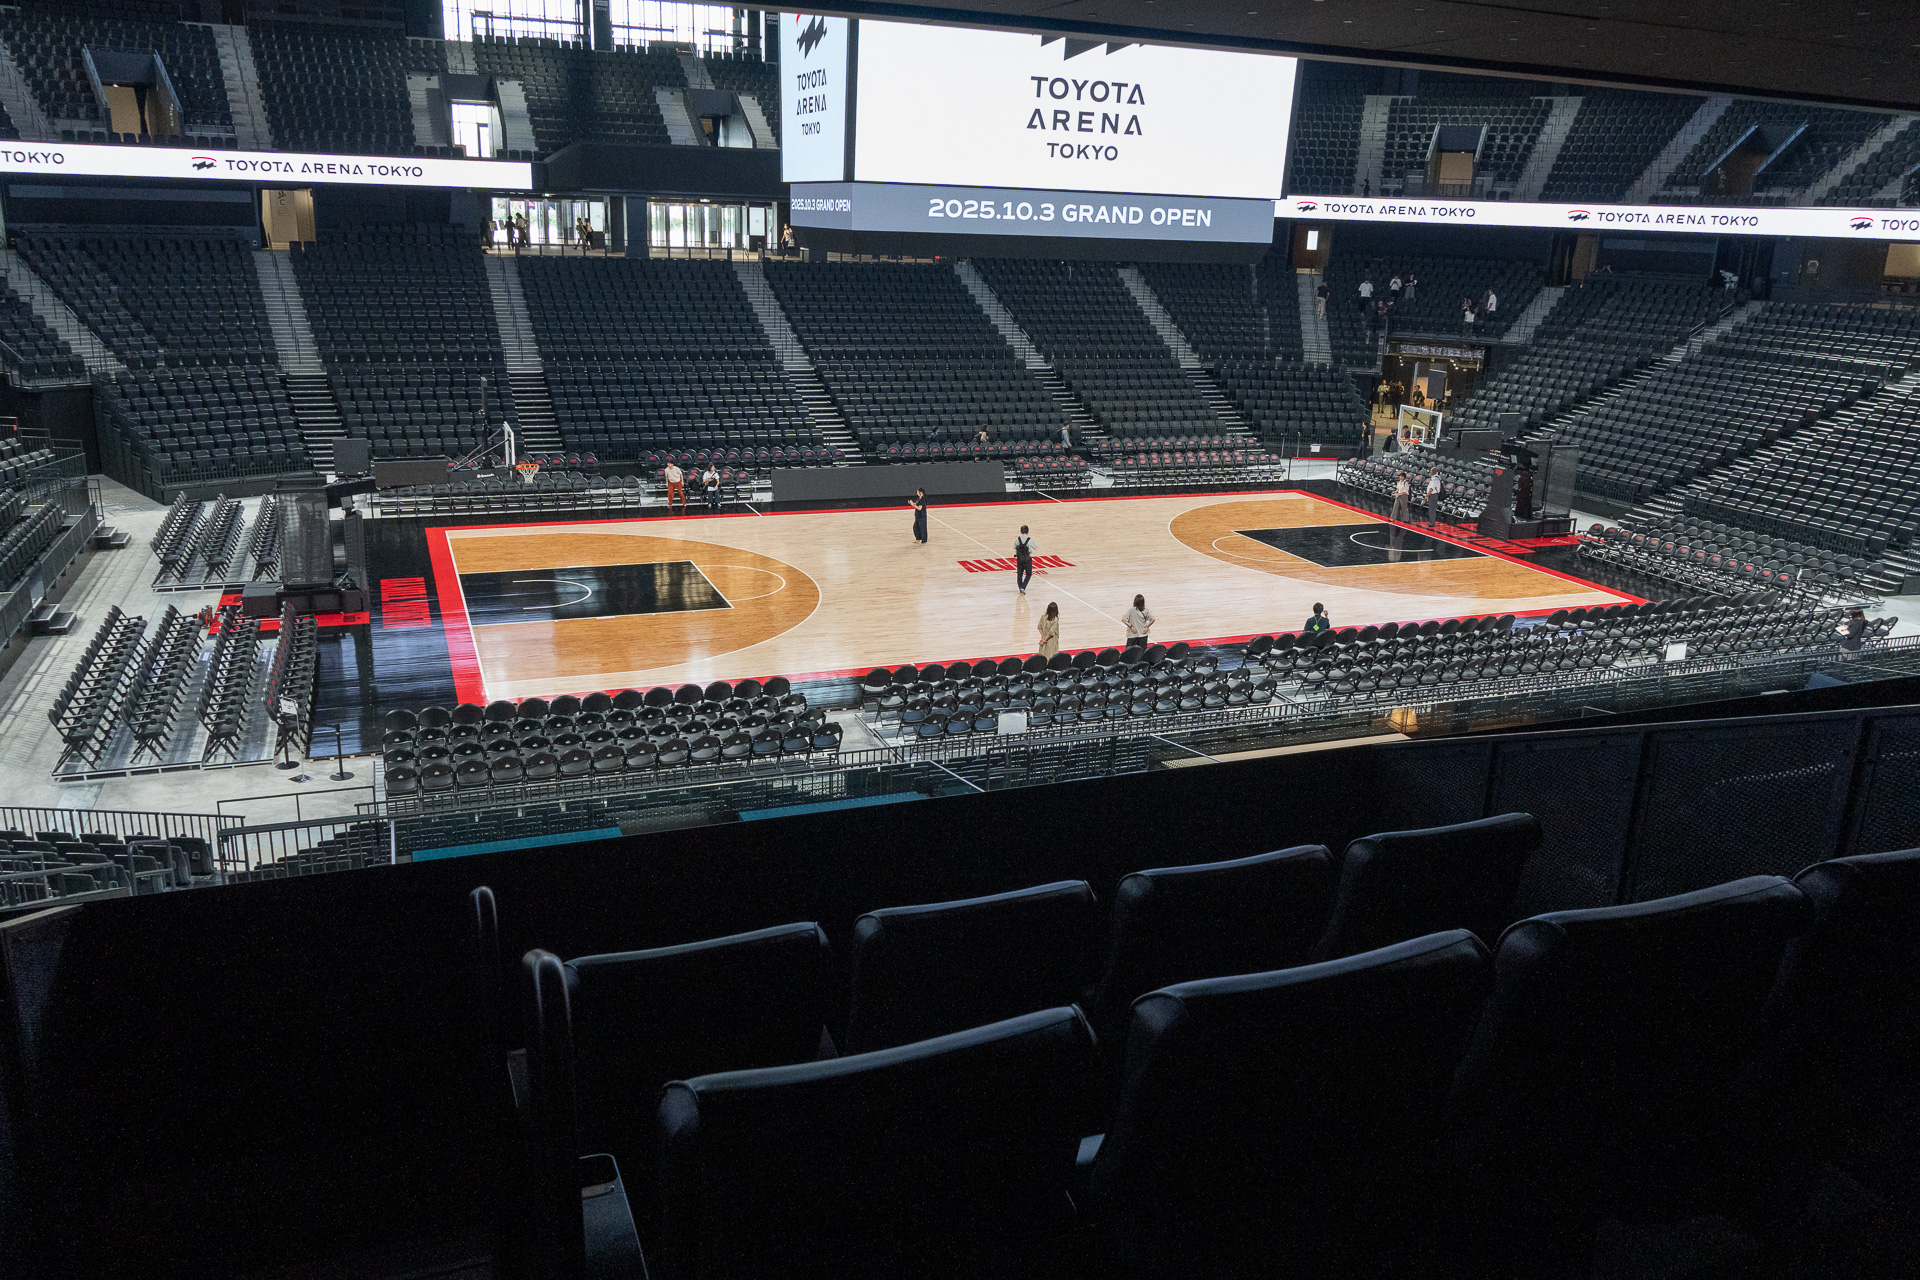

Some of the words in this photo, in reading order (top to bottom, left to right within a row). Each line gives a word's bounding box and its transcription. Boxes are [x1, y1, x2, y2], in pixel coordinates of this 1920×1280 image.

[797, 68, 827, 92] TOYOTA
[1031, 76, 1146, 106] TOYOTA
[796, 94, 827, 116] ARENA
[801, 121, 821, 136] TOKYO
[1026, 107, 1143, 136] ARENA
[0, 150, 65, 165] TOKYO
[1047, 142, 1119, 161] TOKYO
[225, 160, 294, 173] TOYOTA
[301, 163, 364, 175] ARENA
[368, 165, 423, 178] TOKYO
[791, 198, 816, 211] 2025.10.3
[816, 199, 835, 212] GRAND
[835, 199, 851, 212] OPEN
[929, 198, 1055, 222] 2025.10.3
[1062, 203, 1144, 225] GRAND
[1149, 207, 1212, 227] OPEN
[1324, 203, 1374, 214] TOYOTA
[1380, 205, 1427, 216] ARENA
[1431, 207, 1476, 218] TOKYO
[1598, 212, 1650, 223] TOYOTA
[1655, 214, 1706, 225] ARENA
[1710, 216, 1759, 227] TOKYO
[1881, 219, 1920, 231] TOYO
